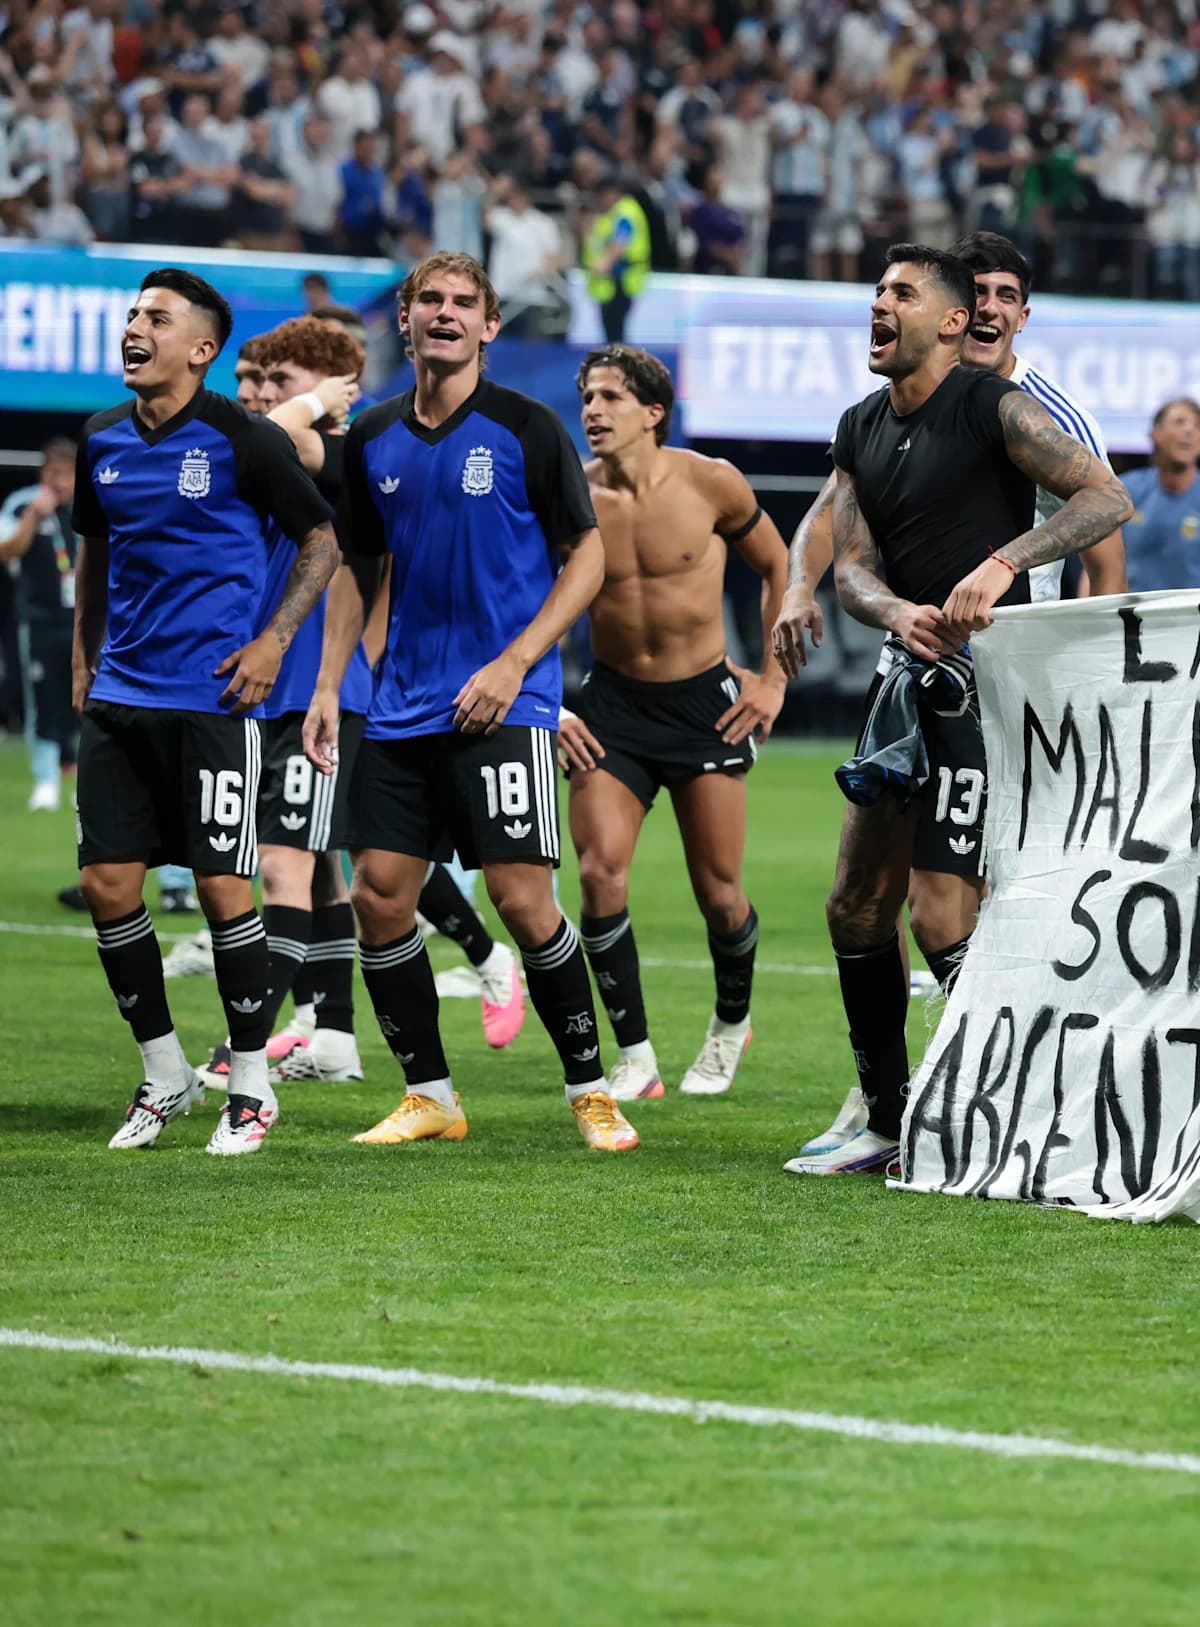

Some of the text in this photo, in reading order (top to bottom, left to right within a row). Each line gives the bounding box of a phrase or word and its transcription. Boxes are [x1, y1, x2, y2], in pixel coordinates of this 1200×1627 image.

[0, 282, 138, 374] ENTI
[709, 327, 842, 397] FIFA
[1067, 345, 1181, 412] CUP
[199, 769, 243, 826] 16
[284, 755, 313, 805] 8
[481, 762, 530, 819] 18
[935, 766, 985, 826] 13
